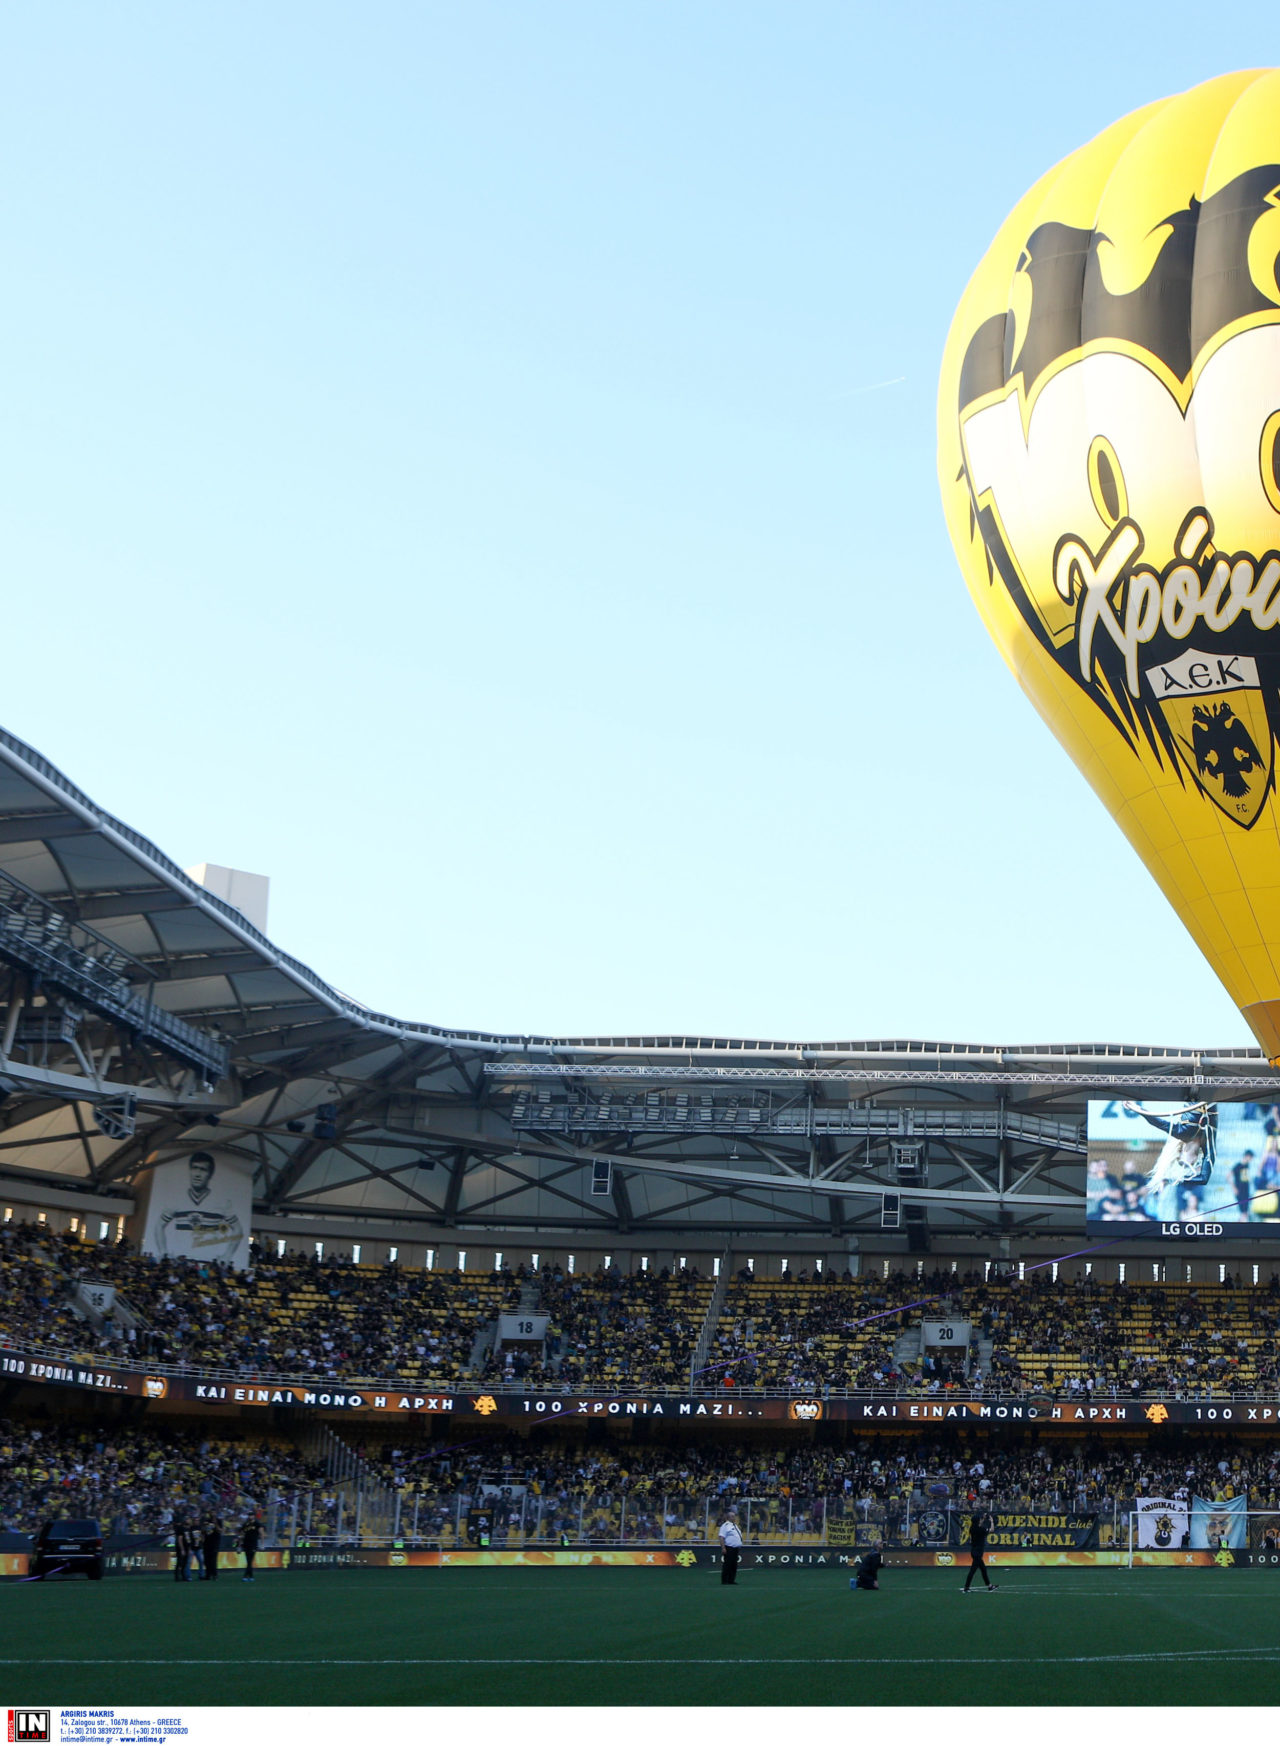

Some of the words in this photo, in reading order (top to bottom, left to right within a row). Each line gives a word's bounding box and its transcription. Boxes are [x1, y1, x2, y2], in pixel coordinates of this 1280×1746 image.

[1235, 803, 1250, 813] F.C.
[1161, 1223, 1180, 1236] LG
[1185, 1223, 1223, 1236] OLED
[518, 1321, 534, 1334] 18
[938, 1328, 954, 1340] 20
[2, 1357, 26, 1375] 100
[28, 1362, 74, 1382] ΧΡΟΝΙΑ
[196, 1385, 227, 1399] ΚΑΙ
[235, 1388, 293, 1403] ΕΙΝΑΙ
[303, 1392, 362, 1407] ΜΟΝΟ
[374, 1396, 388, 1408] Η
[397, 1397, 453, 1411] ΑΡΧΗ
[523, 1400, 562, 1413] 100
[577, 1401, 664, 1414] ΧΡΟΝΙΑ
[863, 1405, 897, 1417] ΚΑΙ
[909, 1405, 967, 1417] ΕΙΝΑΙ
[979, 1406, 1038, 1419] ΜΟΝΟ
[1051, 1407, 1062, 1419] Η
[1074, 1407, 1126, 1419] ΑΡΧΗ
[1196, 1408, 1233, 1420] 100
[997, 1514, 1068, 1528] MENIDI
[1068, 1518, 1093, 1529] club
[755, 1555, 826, 1563] ΧΡΟΝΙΑ
[839, 1555, 908, 1564] ΜΑΙ...
[1249, 1555, 1279, 1563] 100
